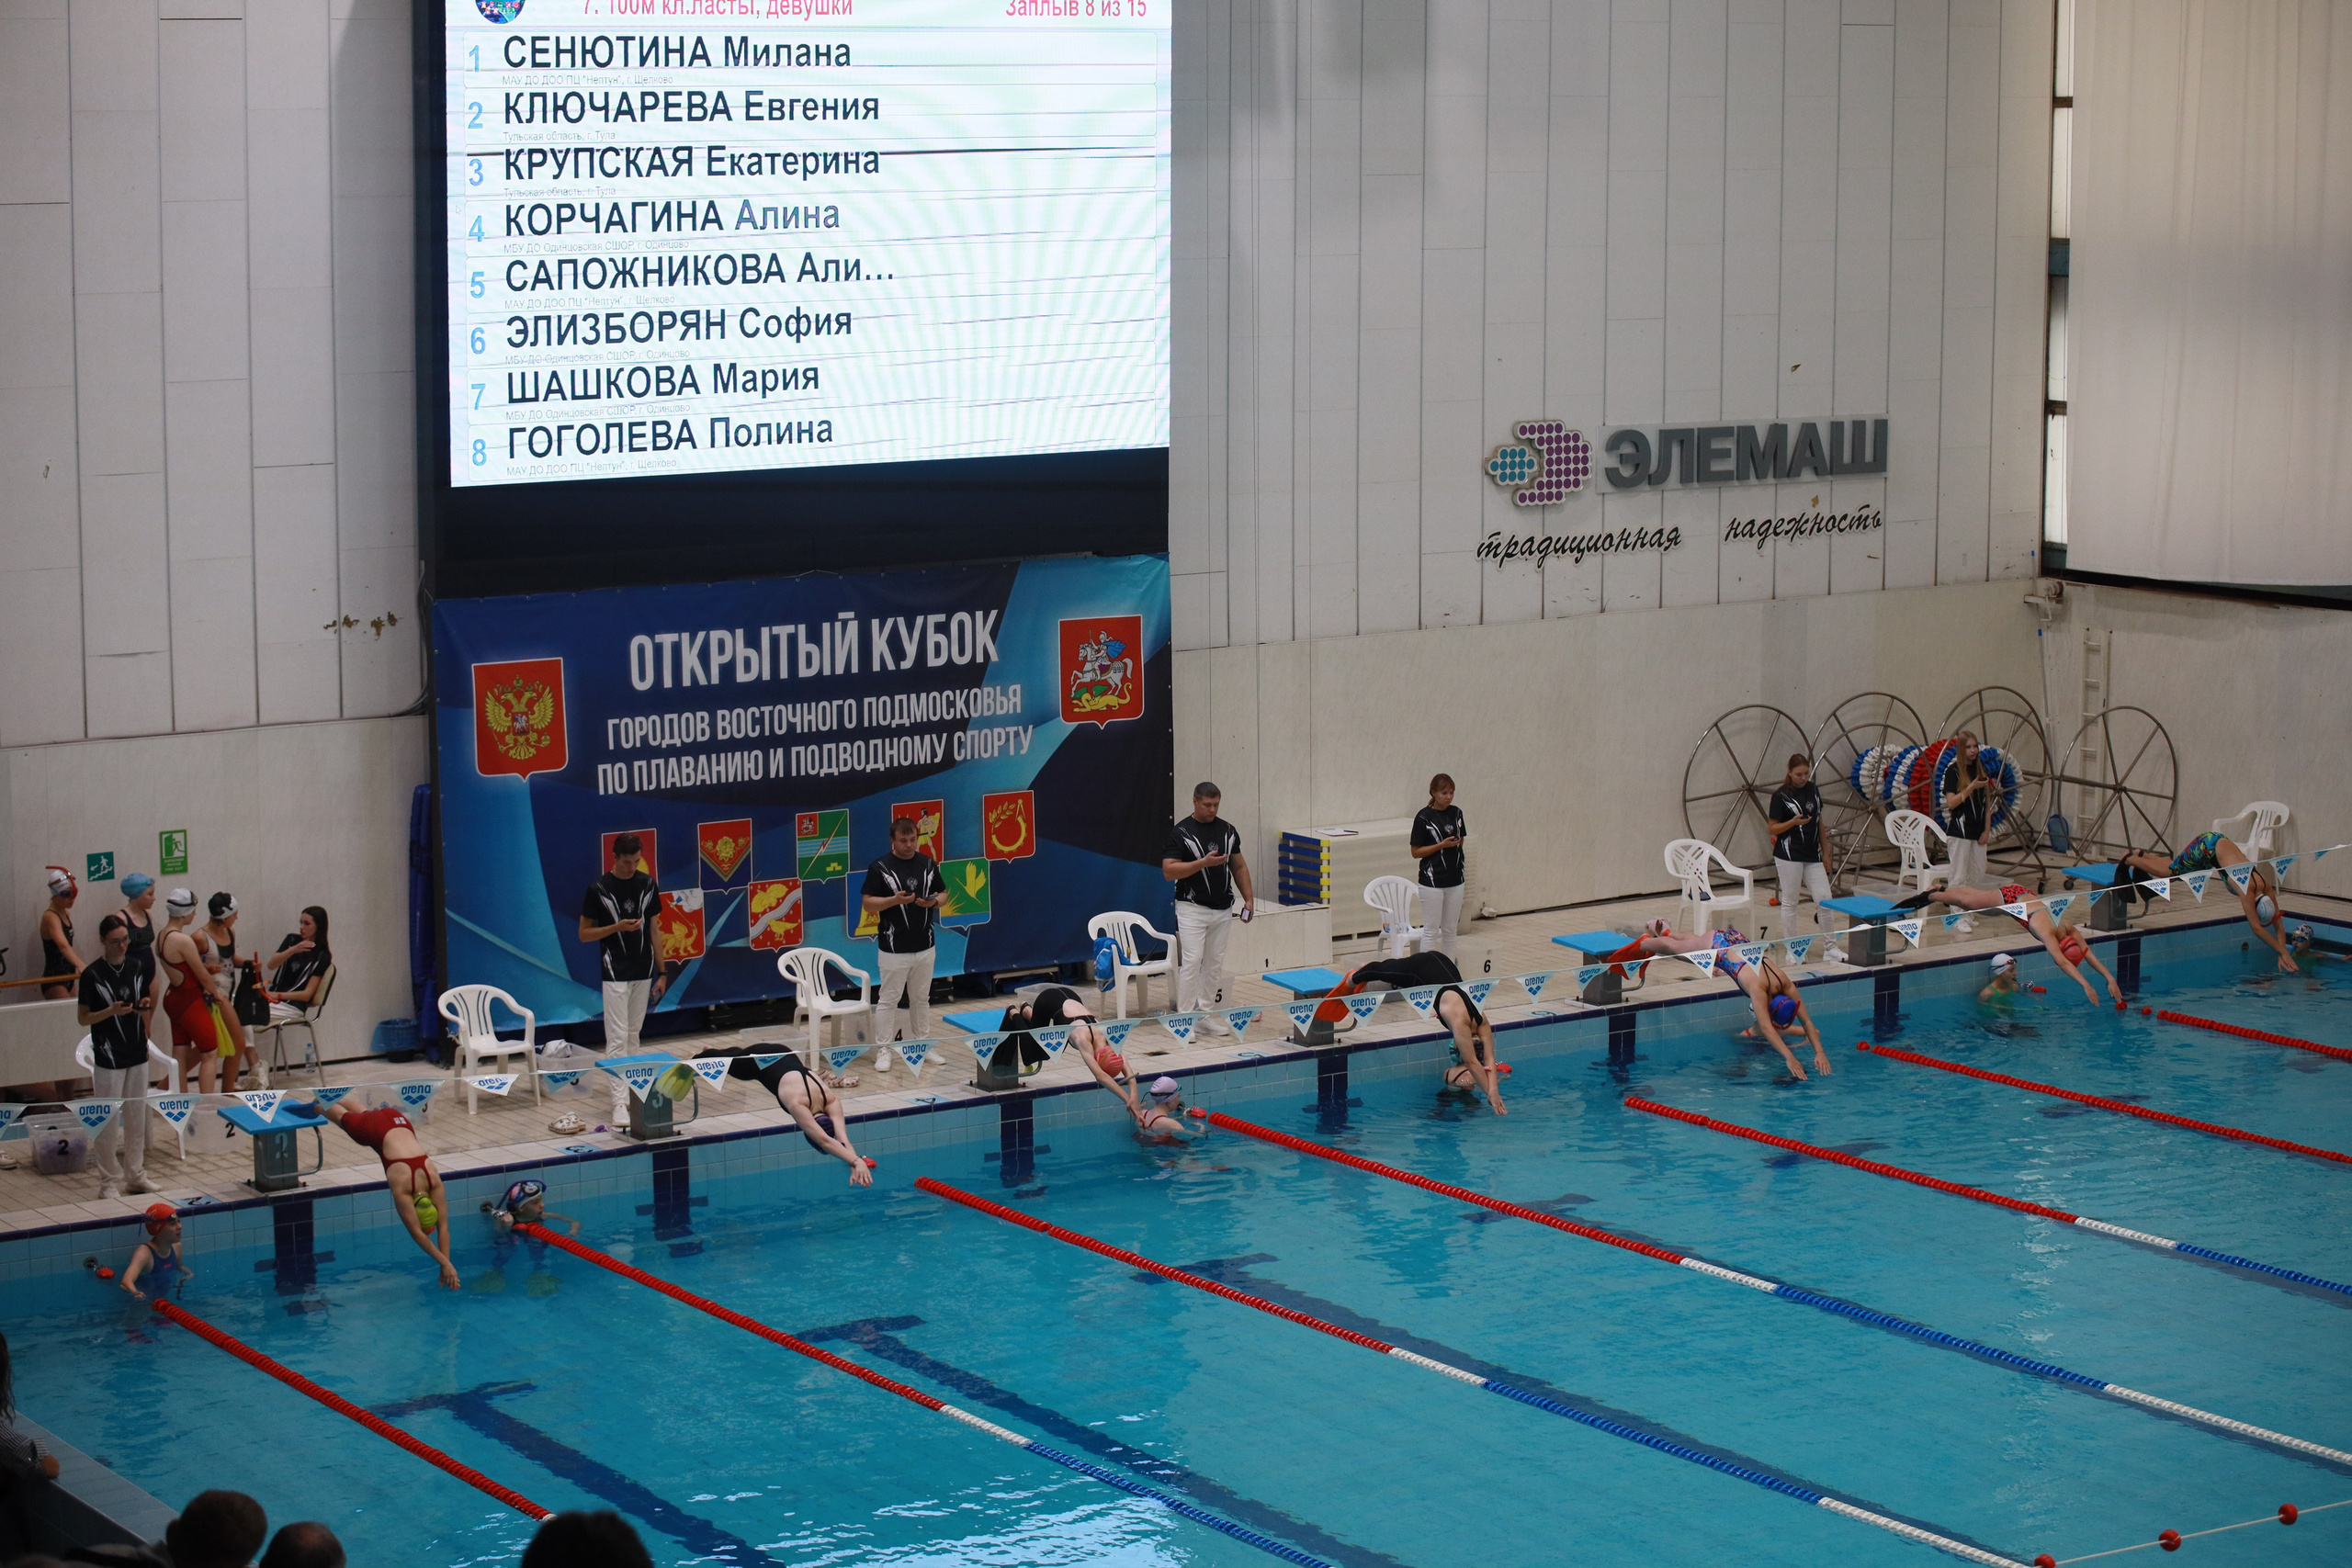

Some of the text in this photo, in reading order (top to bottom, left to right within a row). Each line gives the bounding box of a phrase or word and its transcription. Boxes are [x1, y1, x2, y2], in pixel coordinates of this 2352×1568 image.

[609, 0, 655, 15] 100м
[662, 0, 760, 18] кл.ласты,
[766, 0, 853, 21] девушки
[1005, 0, 1147, 17] Заплыв 8 из 15
[469, 35, 851, 73] 1 СЕНЮТИНА Милана
[468, 90, 879, 130] 2 КЛЮЧАРЕВА Евгения
[469, 145, 879, 186] 3 КРУПСКАЯ Екатерина
[469, 198, 840, 243] 4 КОРЧАГИНА Алина
[470, 252, 893, 299] 5 САПОЖНИКОВА Али...
[470, 306, 852, 355] 6 ЭЛИЗБОРЯН София
[470, 362, 820, 410] 7 ШАШКОВА Мария
[471, 417, 832, 466] 8 ГОГОЛЕВА Полина
[1604, 418, 1889, 490] ЭЛЕМАШ
[1476, 504, 1883, 570] традиционная надежность
[629, 609, 1000, 691] ОТКРЫТЫЙ КУБОК
[607, 683, 1023, 750] ГОРОДОВ ВОСТОЧНОГО ПОДМОСКОВЬЯ
[597, 724, 1035, 795] ПО ПЛАВАНИЮ И ПОДВОДНОМУ СПОРТУ
[1760, 926, 1769, 939] 7
[1790, 939, 1811, 950] arena
[1741, 947, 1761, 957] arena
[1483, 959, 1492, 974] 6
[1525, 976, 1545, 987] arena
[1215, 988, 1223, 1003] 5
[1409, 990, 1433, 1000] arena
[1468, 983, 1490, 995] arena
[1290, 1003, 1314, 1014] arena
[1351, 998, 1376, 1008] arena
[1168, 1017, 1193, 1028] arena
[1229, 1010, 1252, 1022] arena
[894, 1028, 903, 1042] 4
[1039, 1031, 1066, 1041] arena
[1106, 1023, 1130, 1035] arena
[902, 1043, 927, 1055] arena
[973, 1037, 999, 1048] arena
[831, 1050, 858, 1061] arena
[695, 1060, 726, 1071] arena
[625, 1067, 653, 1079] arena
[401, 1084, 432, 1096] arena
[79, 1104, 110, 1116] arena
[159, 1099, 189, 1111] arena
[225, 1122, 236, 1138] 2
[57, 1139, 70, 1156] 2
[275, 1132, 288, 1159] 2
